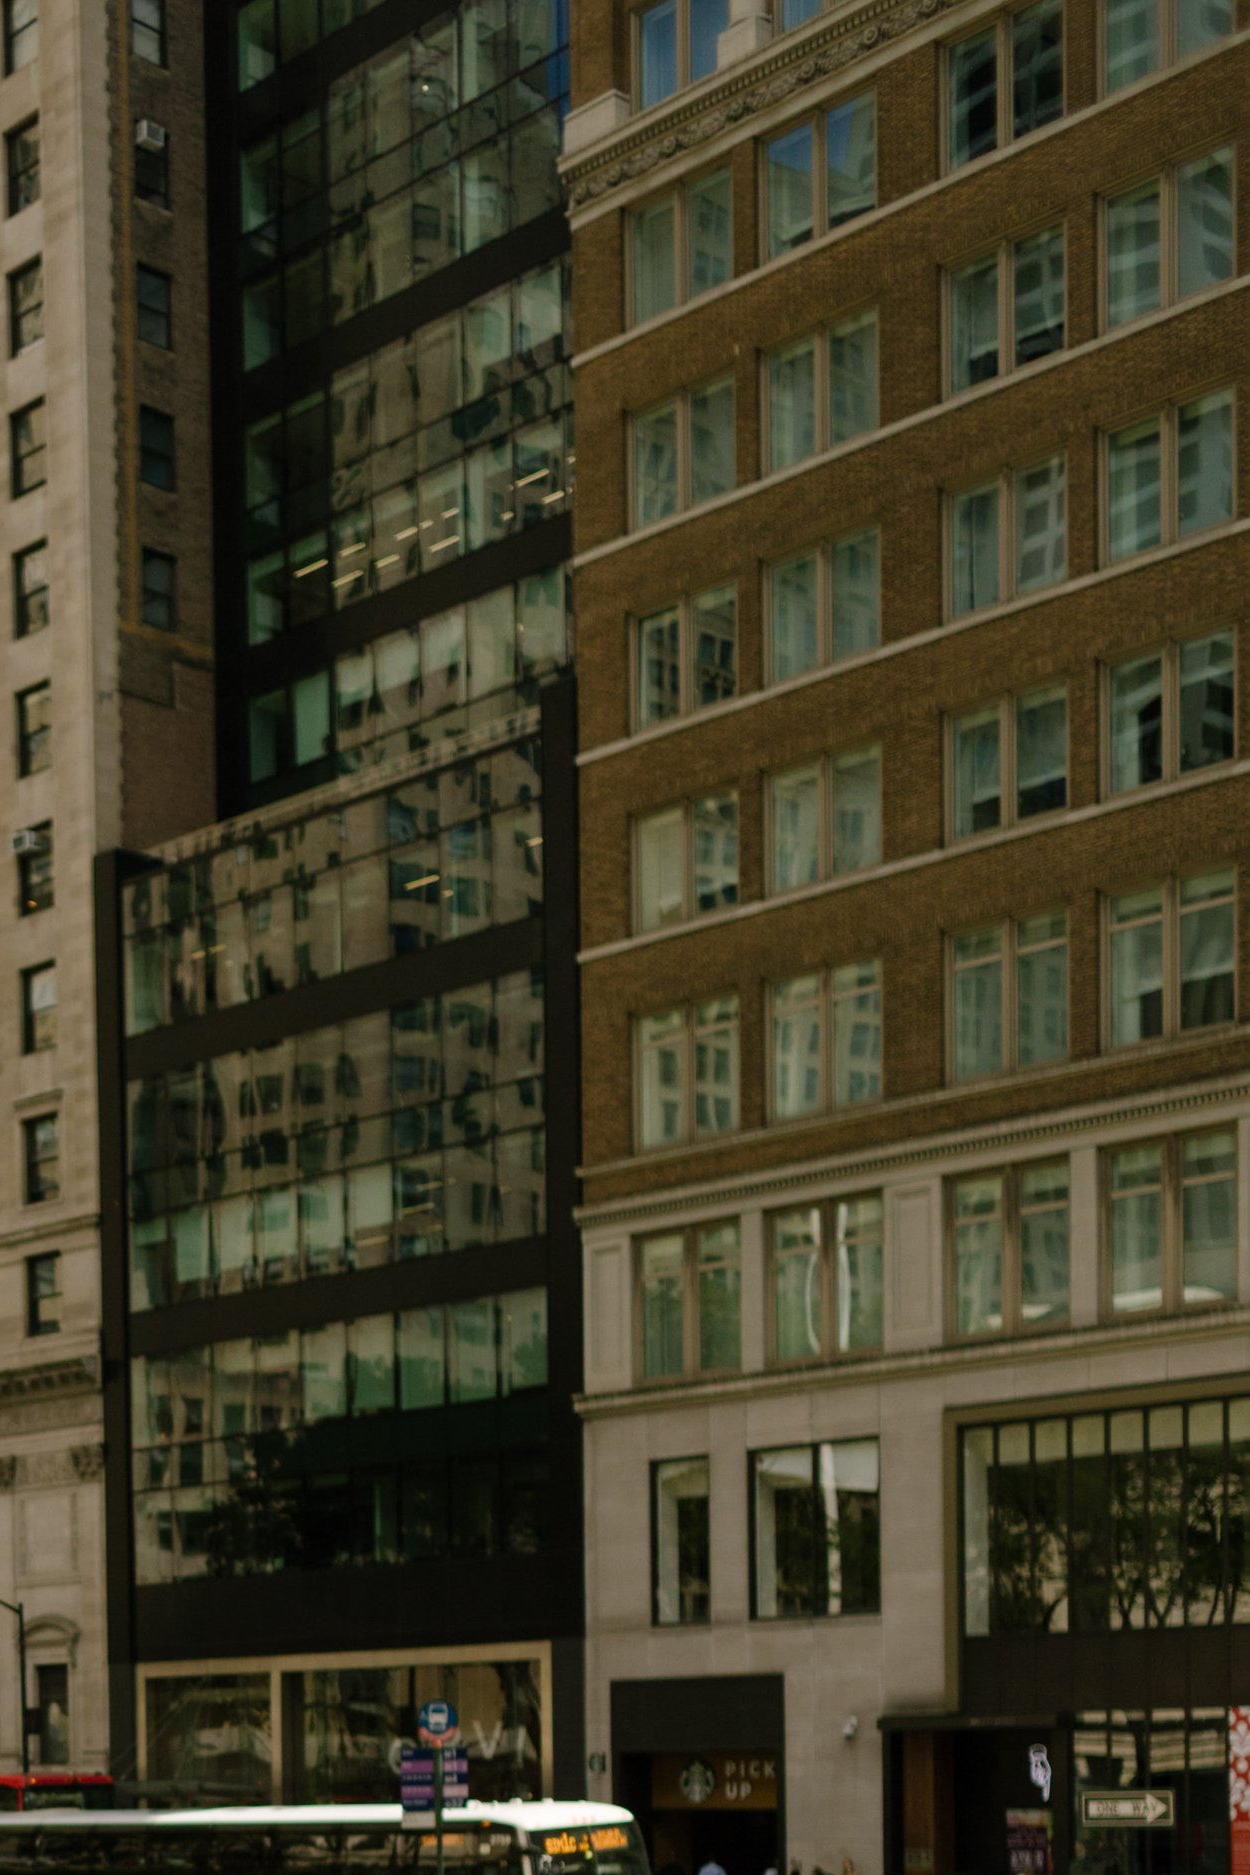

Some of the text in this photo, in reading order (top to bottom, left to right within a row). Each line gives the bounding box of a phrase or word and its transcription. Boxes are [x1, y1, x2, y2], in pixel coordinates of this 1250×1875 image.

[725, 1760, 776, 1779] PICK
[725, 1781, 752, 1801] UP
[1096, 1801, 1158, 1816] ONE WAY
